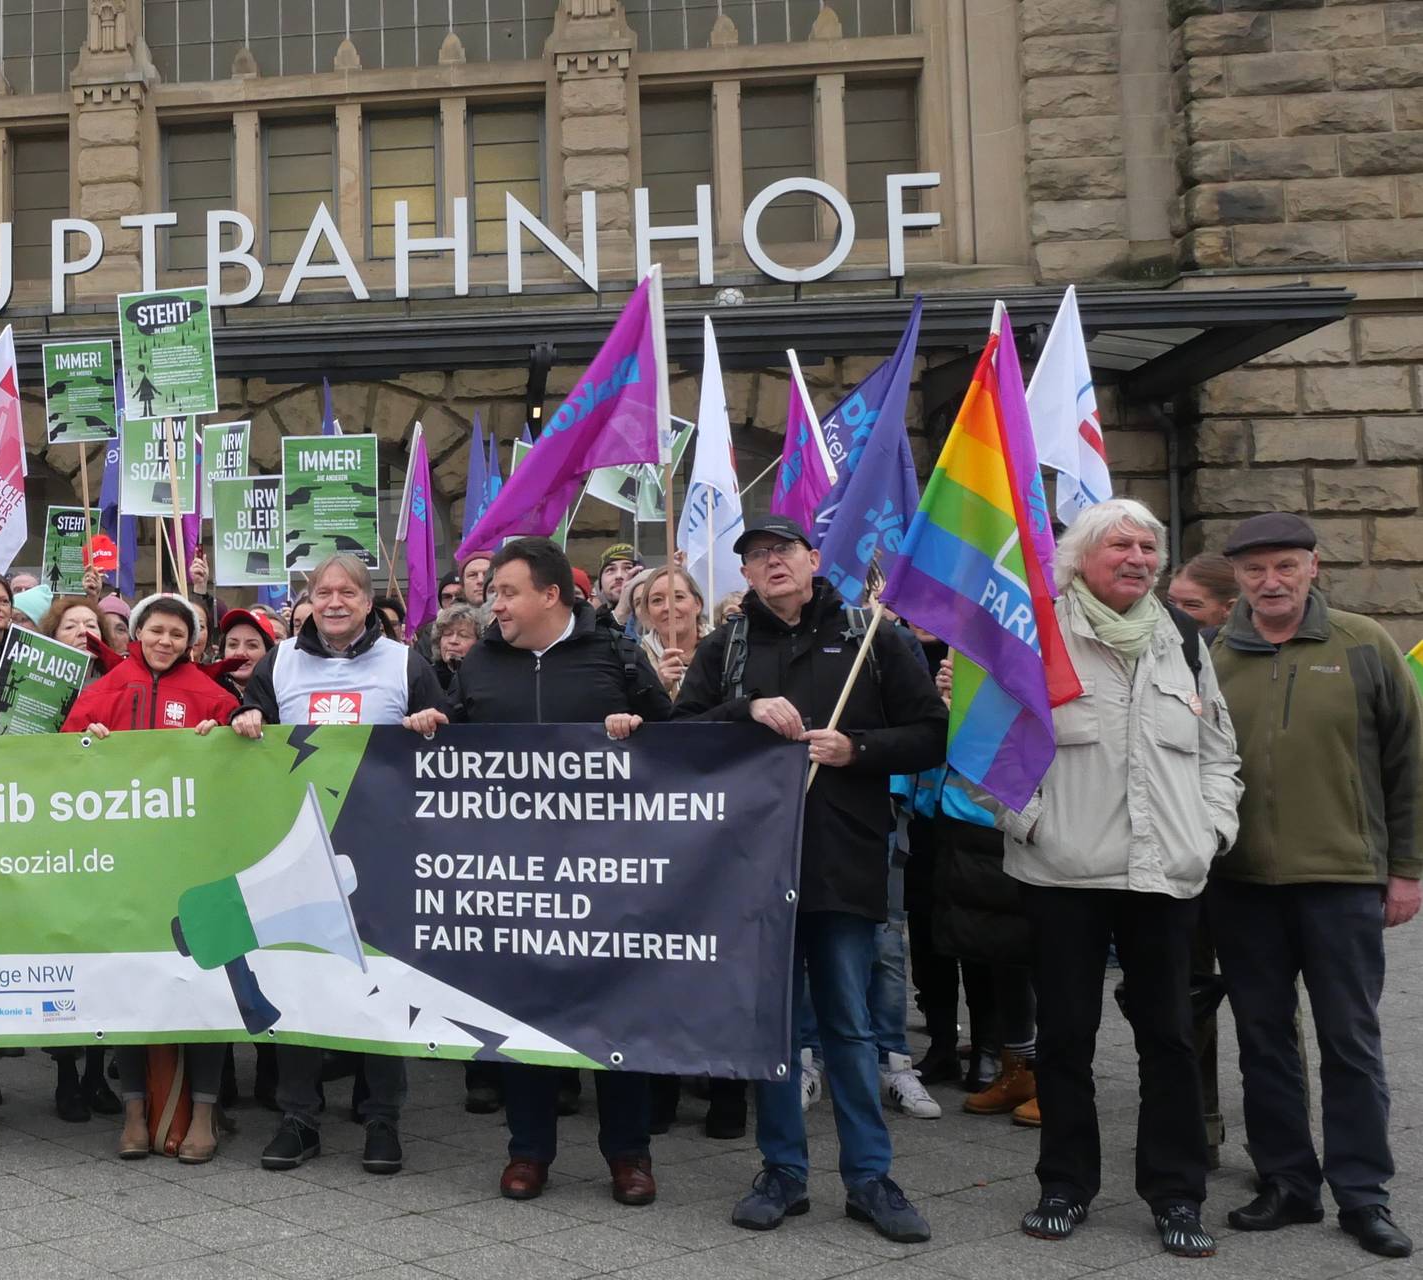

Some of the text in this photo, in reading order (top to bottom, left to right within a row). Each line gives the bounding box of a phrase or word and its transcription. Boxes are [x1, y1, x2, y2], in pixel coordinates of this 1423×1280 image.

[137, 301, 191, 326] STEHT!
[55, 351, 102, 370] IMMER!
[221, 432, 245, 450] NRW
[216, 450, 243, 469] BLEIB
[298, 449, 361, 472] IMMER!
[244, 488, 278, 508] NRW
[237, 509, 279, 529] BLEIB
[223, 530, 280, 550] SOZIAL!
[7, 640, 82, 684] APPLAUS!
[415, 745, 631, 780] KÜRZUNGEN
[50, 777, 196, 822] sozial!
[415, 785, 725, 821] ZURÜCKNEHMEN!
[414, 853, 670, 884] SOZIALE ARBEIT
[415, 889, 591, 919] IN KREFELD
[414, 924, 717, 962] FAIR FINANZIEREN!
[27, 965, 74, 983] NRW
